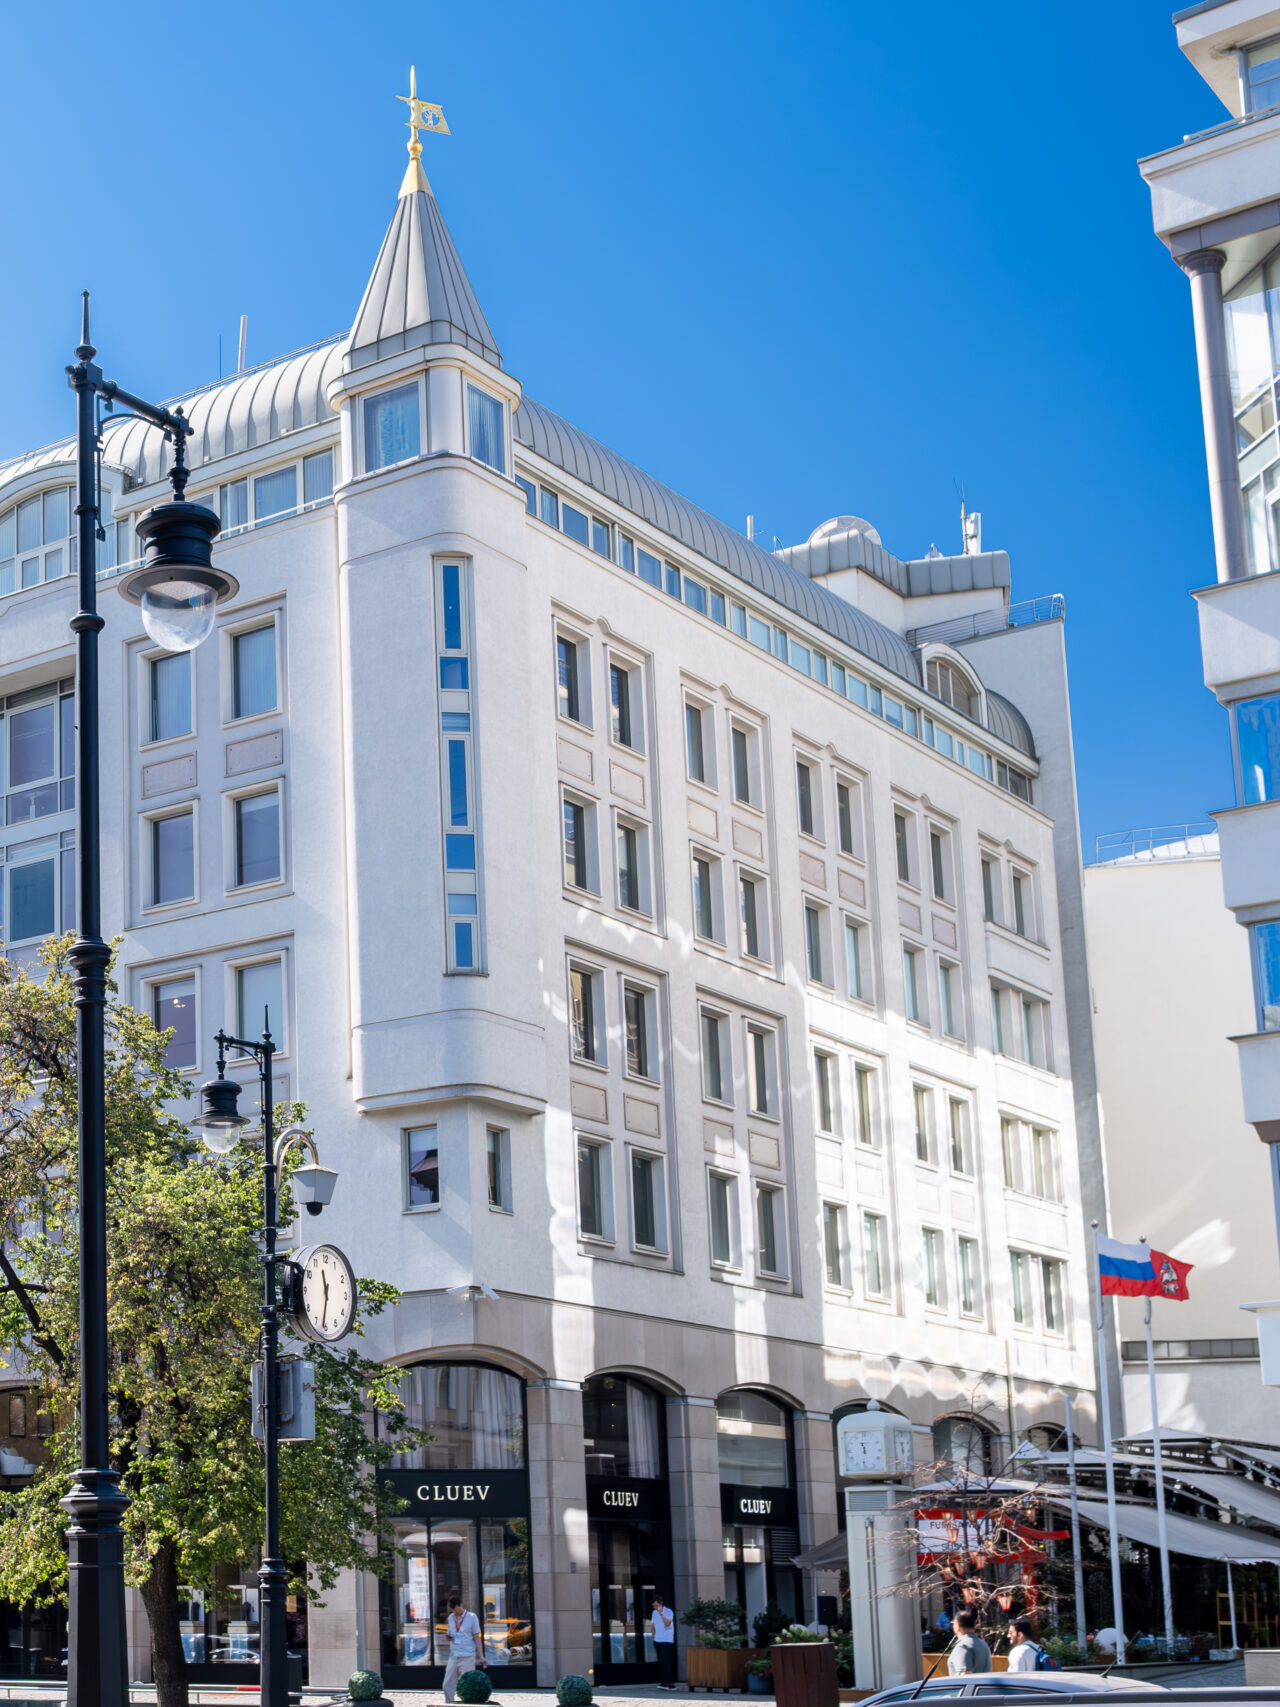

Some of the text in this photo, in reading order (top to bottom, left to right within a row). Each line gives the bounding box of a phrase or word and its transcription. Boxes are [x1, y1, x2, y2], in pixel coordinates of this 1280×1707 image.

[416, 1485, 490, 1501] CLUEV
[603, 1490, 639, 1507] CLUEV
[740, 1498, 772, 1514] CLUEV
